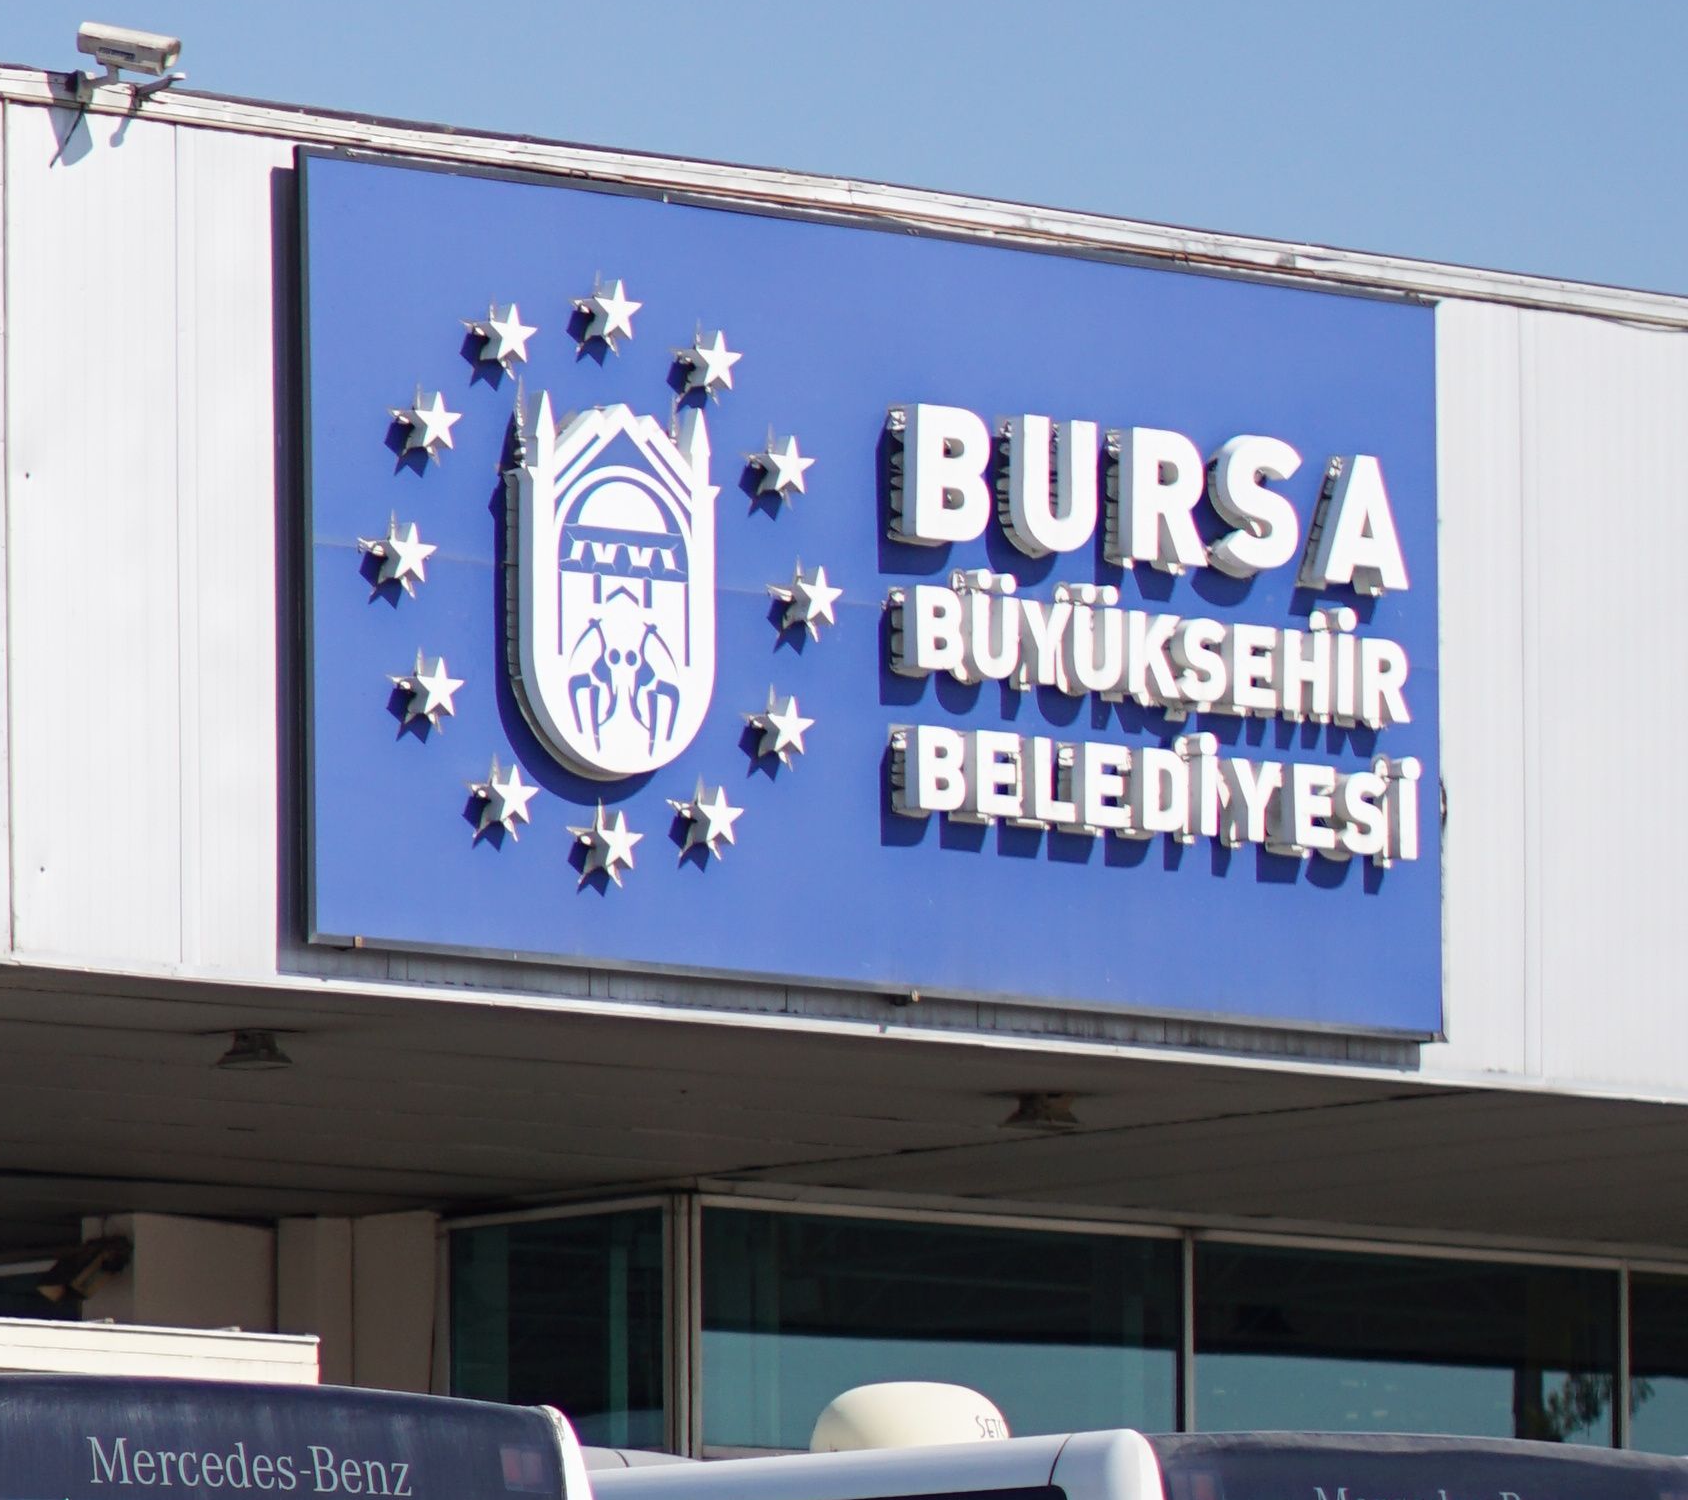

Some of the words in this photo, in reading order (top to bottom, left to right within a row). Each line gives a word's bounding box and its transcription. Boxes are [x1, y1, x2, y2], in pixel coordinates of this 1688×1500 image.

[888, 402, 1408, 596] BURSA
[888, 569, 1410, 728] BÜYÜKŞEHİR
[889, 724, 1421, 867] BELEDİYESİ
[87, 1436, 413, 1498] Mercedes-Benz
